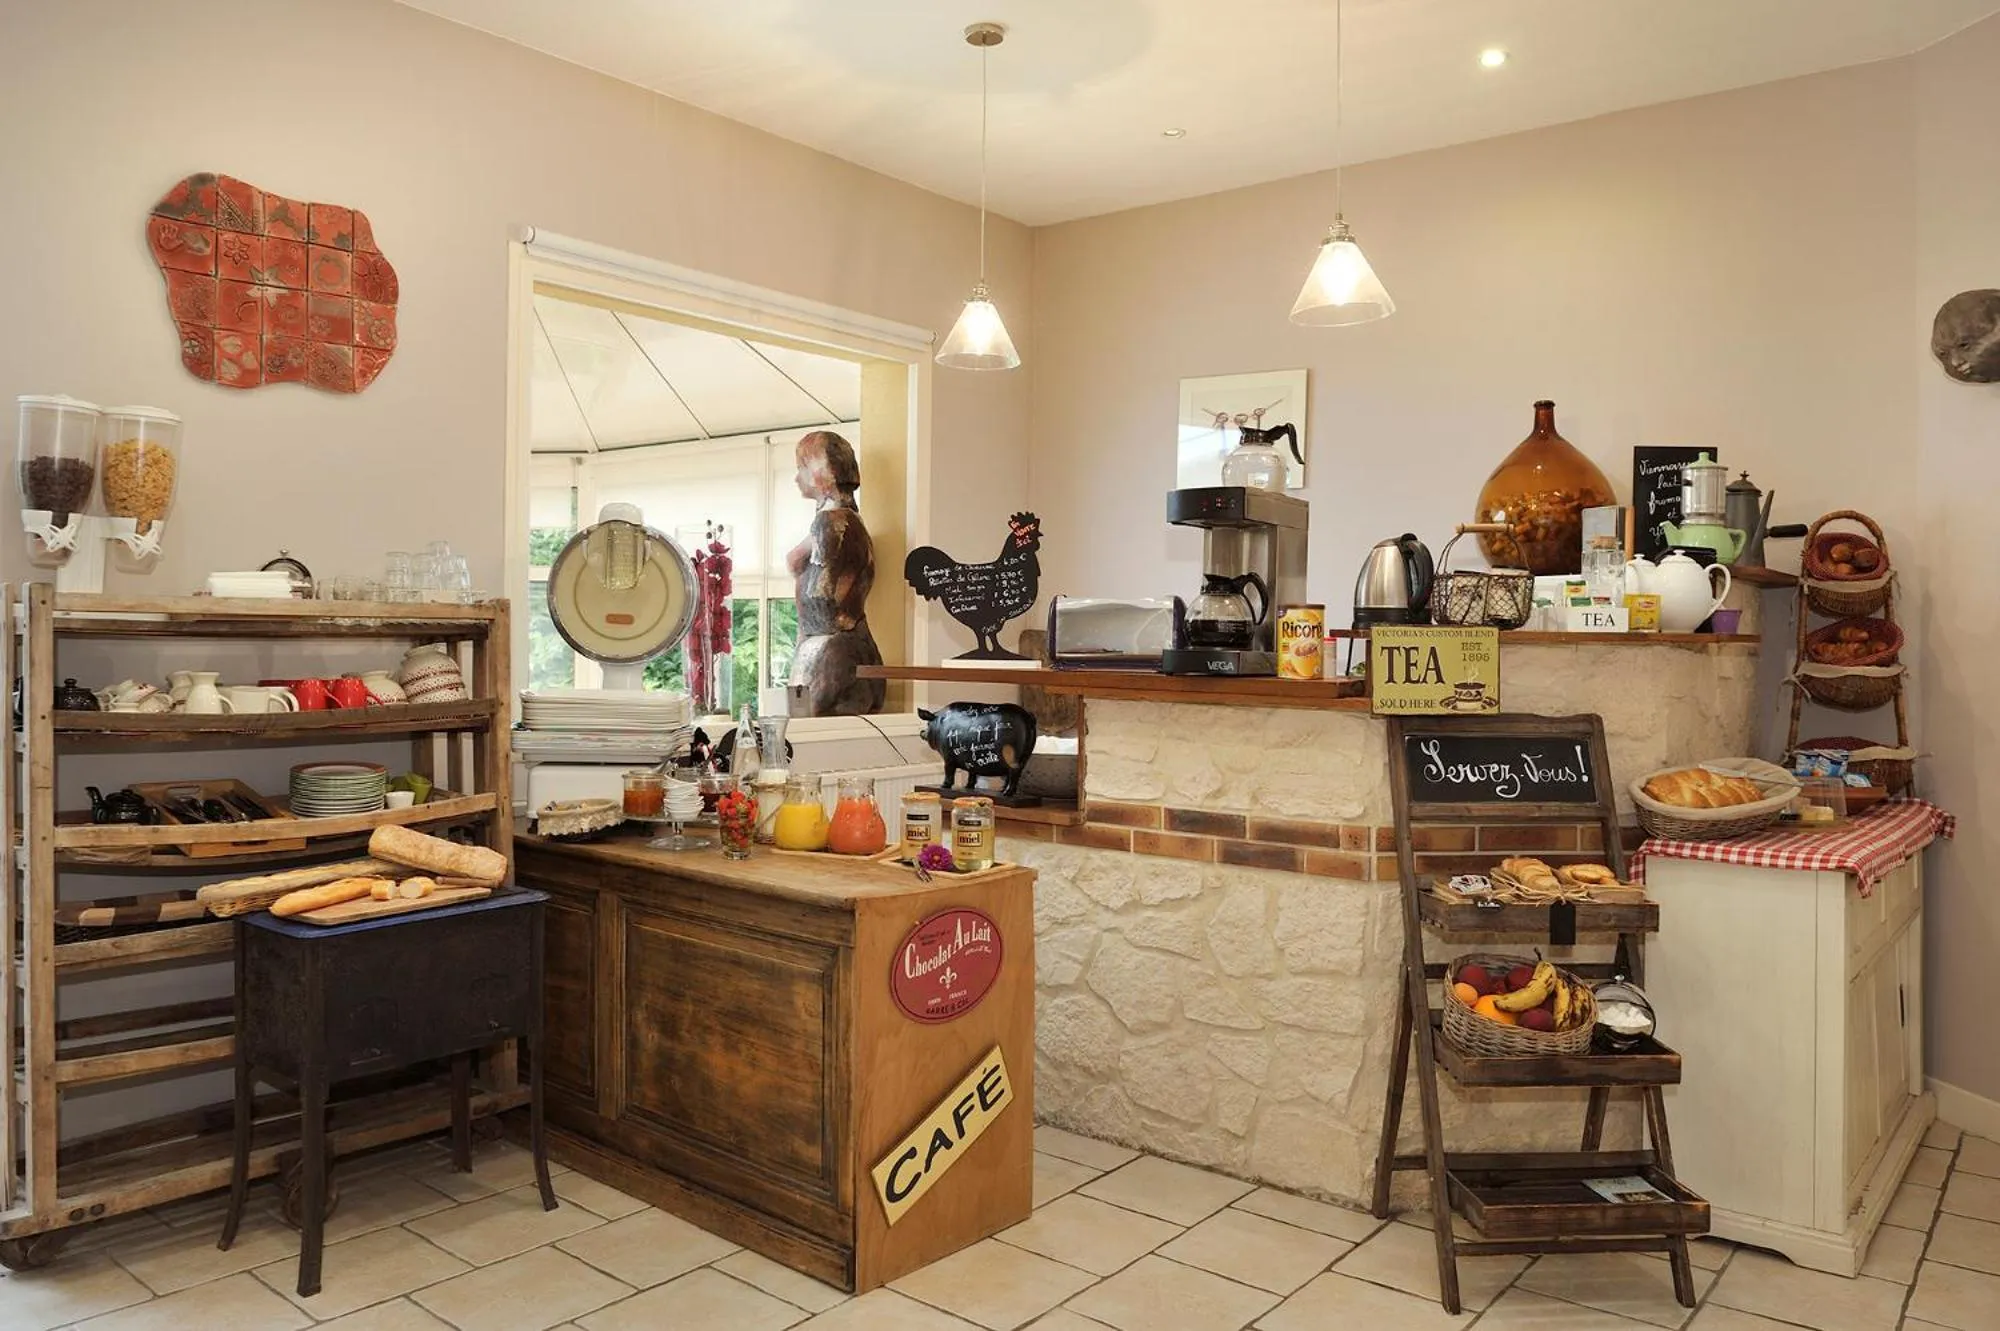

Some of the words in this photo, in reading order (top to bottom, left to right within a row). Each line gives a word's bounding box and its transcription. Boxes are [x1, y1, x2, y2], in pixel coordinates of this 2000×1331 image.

[1582, 612, 1615, 627] TEA
[1282, 621, 1323, 639] Ricoré
[1426, 629, 1462, 638] CUSTOM
[1464, 629, 1494, 638] BLEND
[1207, 661, 1234, 671] VEGA
[1380, 646, 1446, 685] TEA
[1380, 699, 1406, 708] SOLD
[1409, 699, 1435, 708] HERE
[959, 833, 980, 843] miel
[904, 943, 951, 979] Chocolat
[952, 918, 971, 955] Au
[972, 920, 991, 942] Lait
[885, 1064, 1005, 1204] CAFÉ
